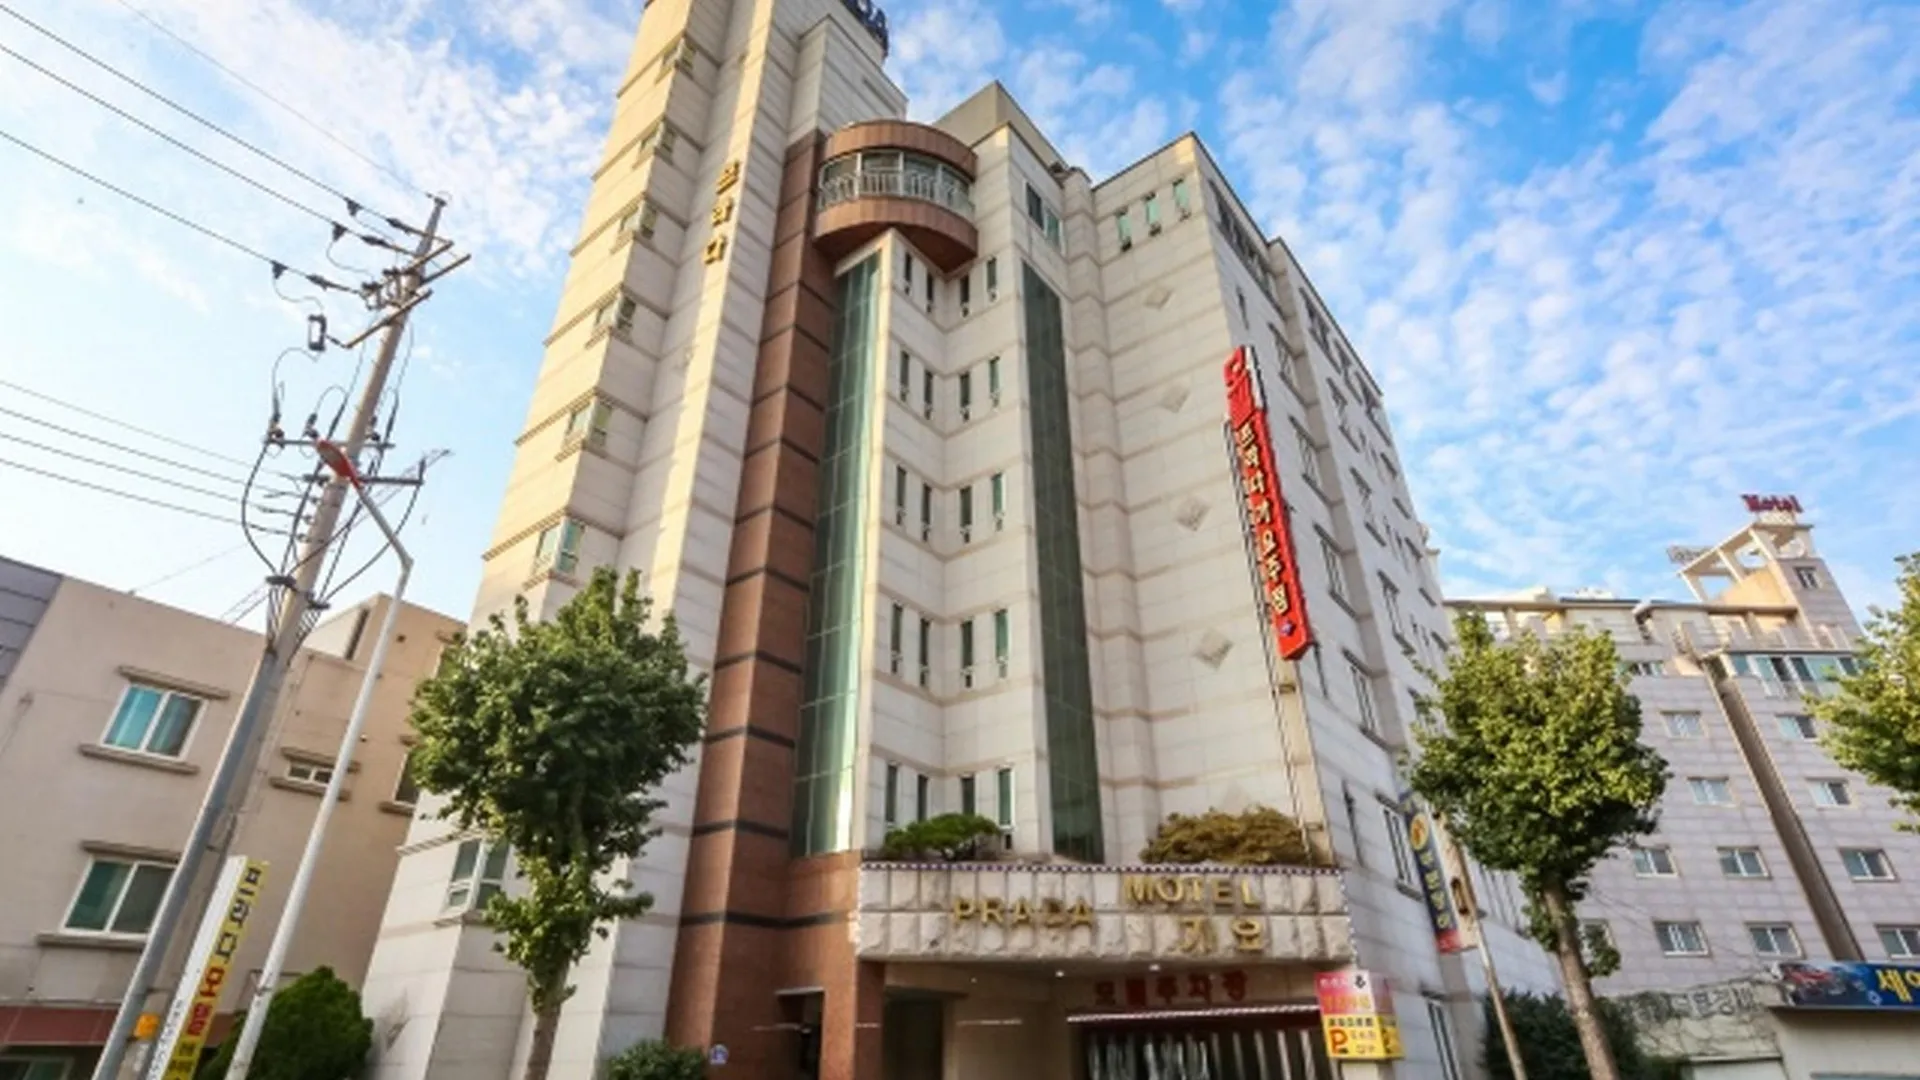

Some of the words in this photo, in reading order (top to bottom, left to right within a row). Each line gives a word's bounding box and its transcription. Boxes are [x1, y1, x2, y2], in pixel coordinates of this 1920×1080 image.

[1124, 874, 1258, 910] MOTEL
[953, 896, 1095, 928] PRADA
[1176, 917, 1265, 953] 가요
